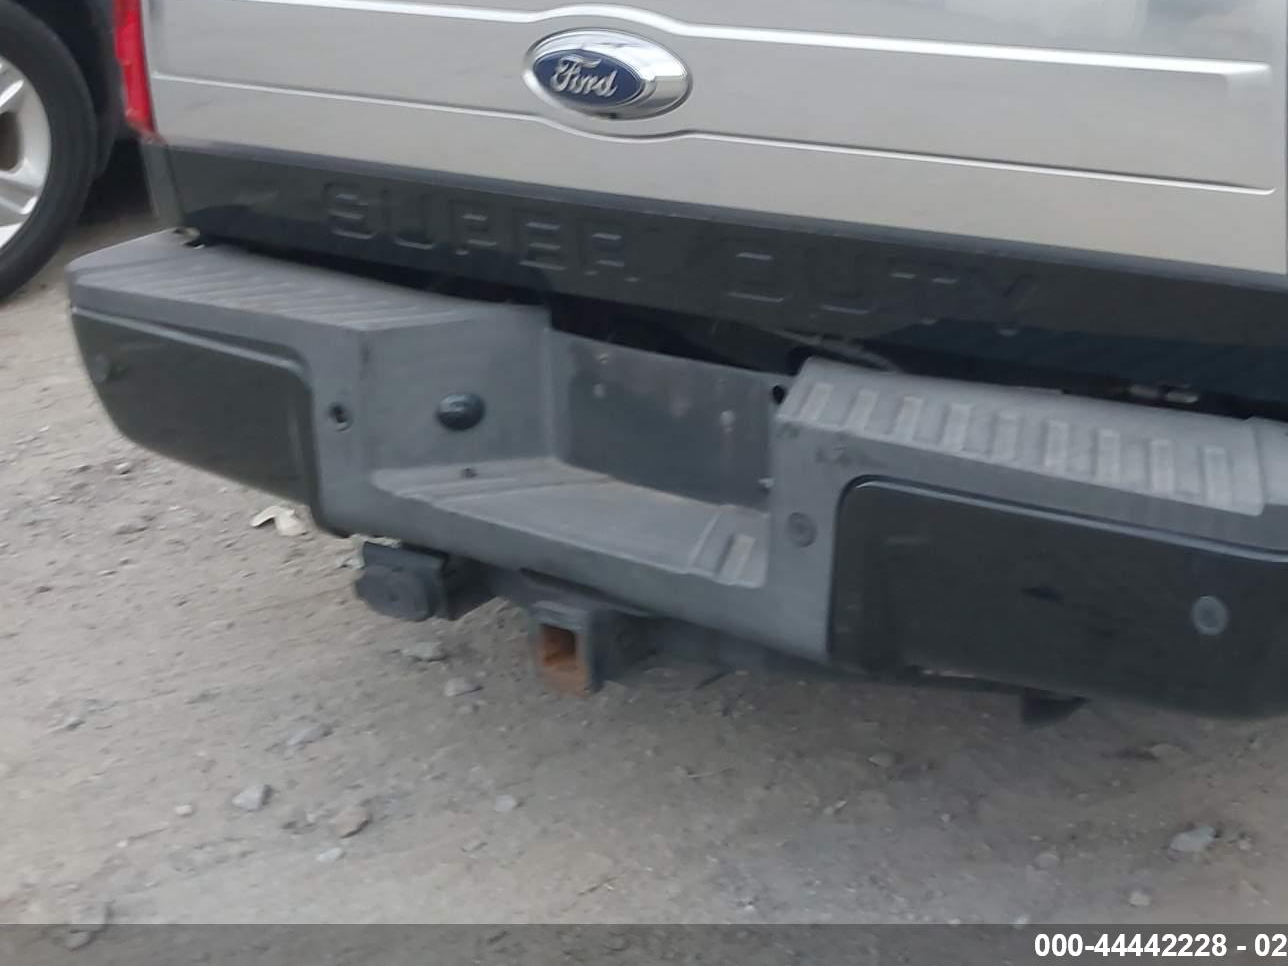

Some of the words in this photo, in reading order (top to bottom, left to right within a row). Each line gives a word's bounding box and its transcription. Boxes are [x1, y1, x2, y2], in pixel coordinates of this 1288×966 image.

[550, 54, 619, 98] Ford
[323, 181, 638, 283] SUPER
[727, 249, 1037, 336] DUTY
